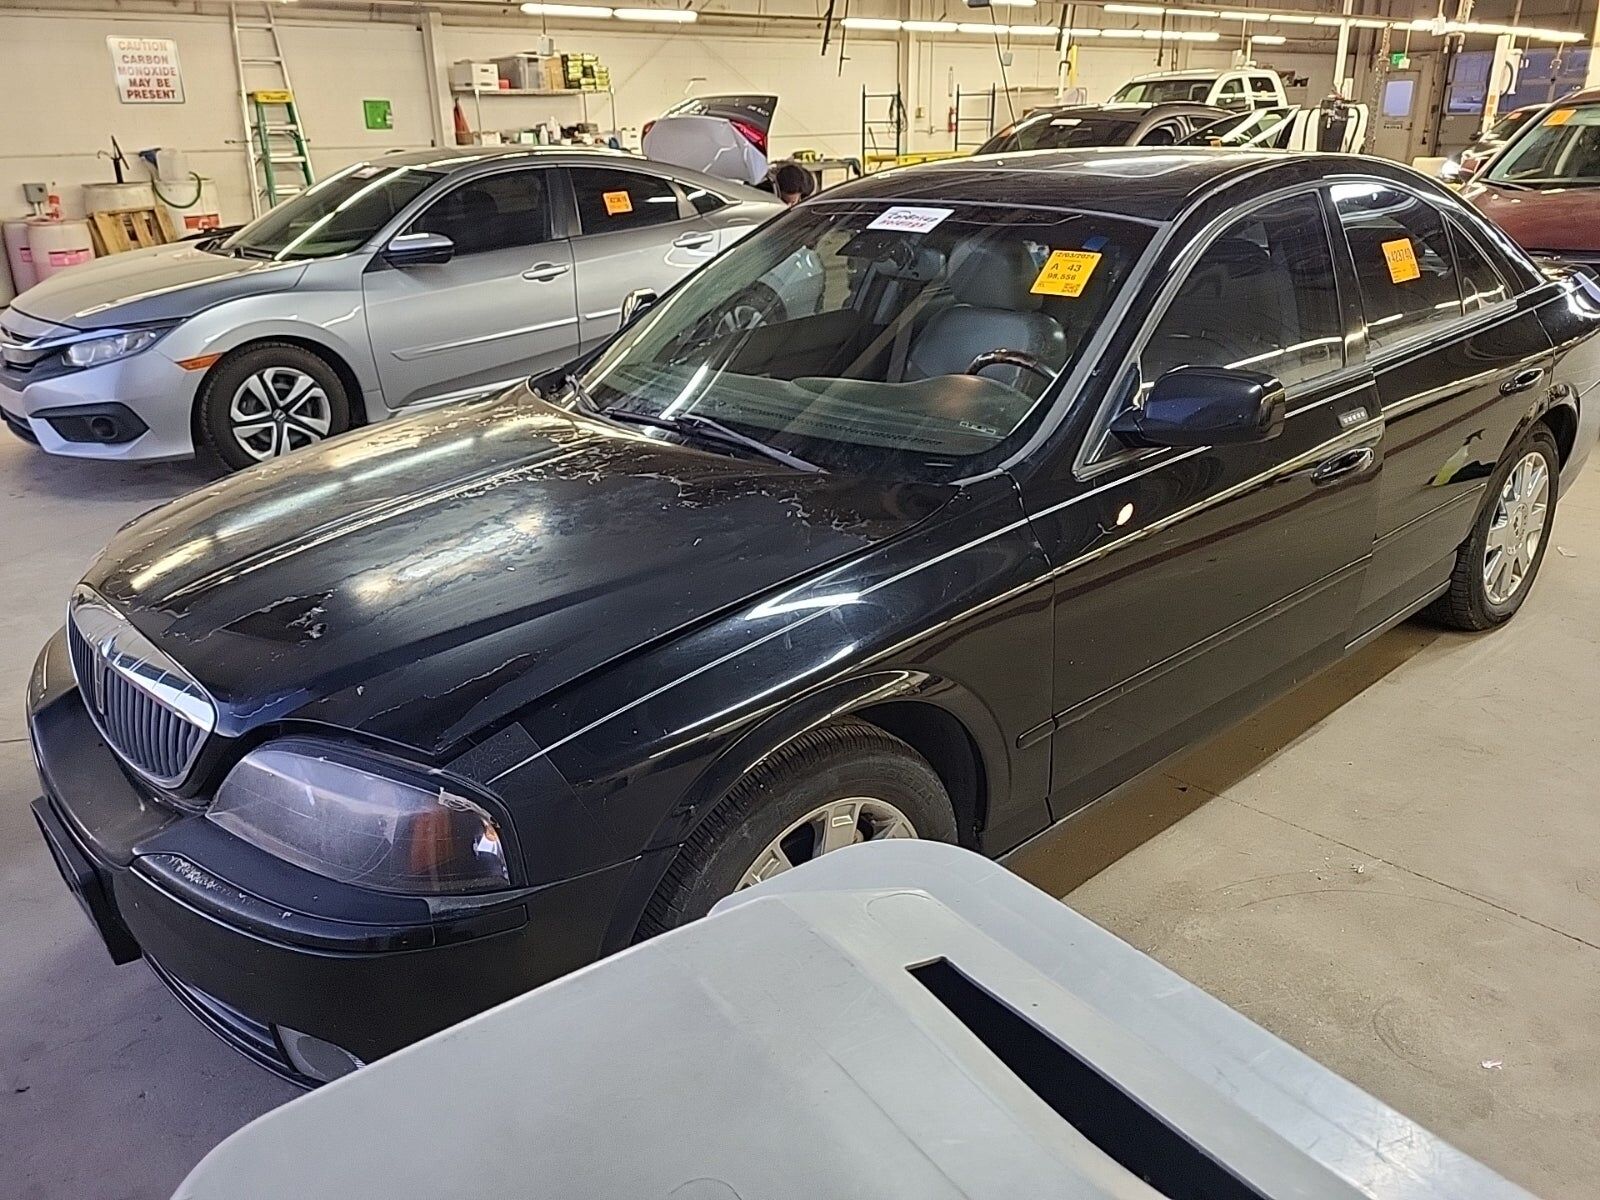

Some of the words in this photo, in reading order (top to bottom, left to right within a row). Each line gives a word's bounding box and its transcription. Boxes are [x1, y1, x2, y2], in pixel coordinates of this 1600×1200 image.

[118, 41, 168, 51] CAUTION
[121, 55, 169, 65] CARBON
[117, 66, 177, 76] MONOXIDE
[128, 78, 151, 88] MAY
[157, 78, 171, 88] BE
[126, 89, 176, 99] PRESENT
[1067, 264, 1082, 272] 43
